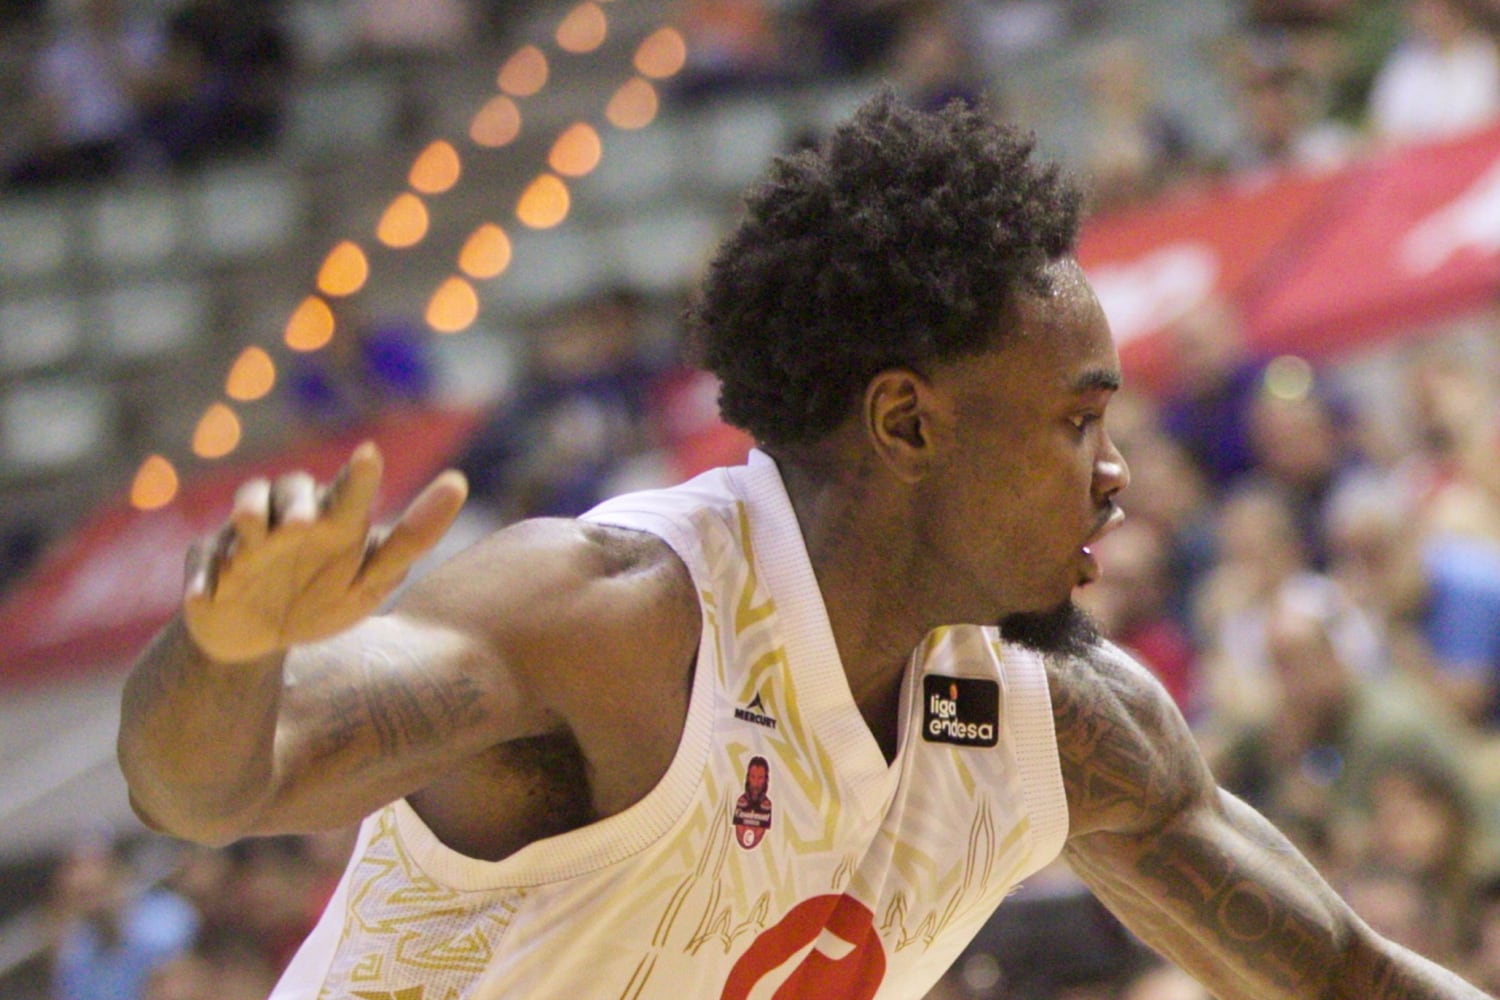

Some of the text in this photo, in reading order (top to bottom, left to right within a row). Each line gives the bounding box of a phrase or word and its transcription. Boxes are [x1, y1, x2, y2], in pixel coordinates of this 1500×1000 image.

[930, 694, 957, 718] liga
[734, 708, 777, 730] MERCURY
[929, 717, 993, 740] endesa
